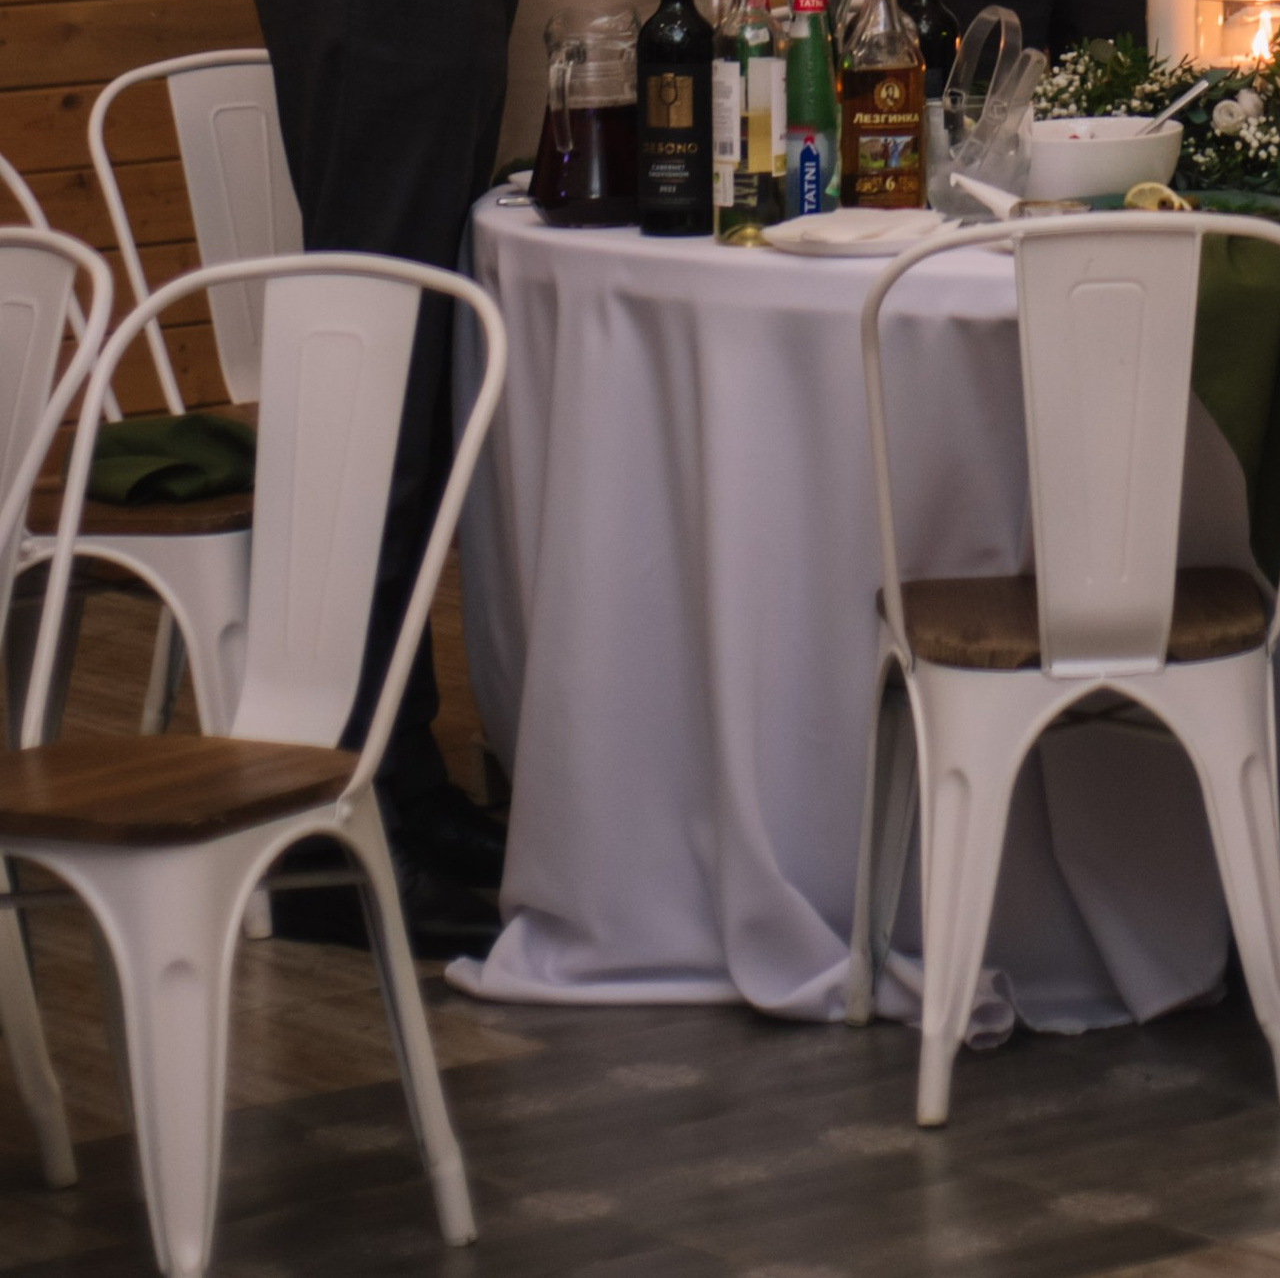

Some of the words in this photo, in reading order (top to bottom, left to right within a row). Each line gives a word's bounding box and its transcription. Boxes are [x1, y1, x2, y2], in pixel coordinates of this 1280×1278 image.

[853, 112, 919, 124] ЛЕЗГИНКА
[804, 162, 816, 214] TATNI
[885, 176, 896, 191] 6
